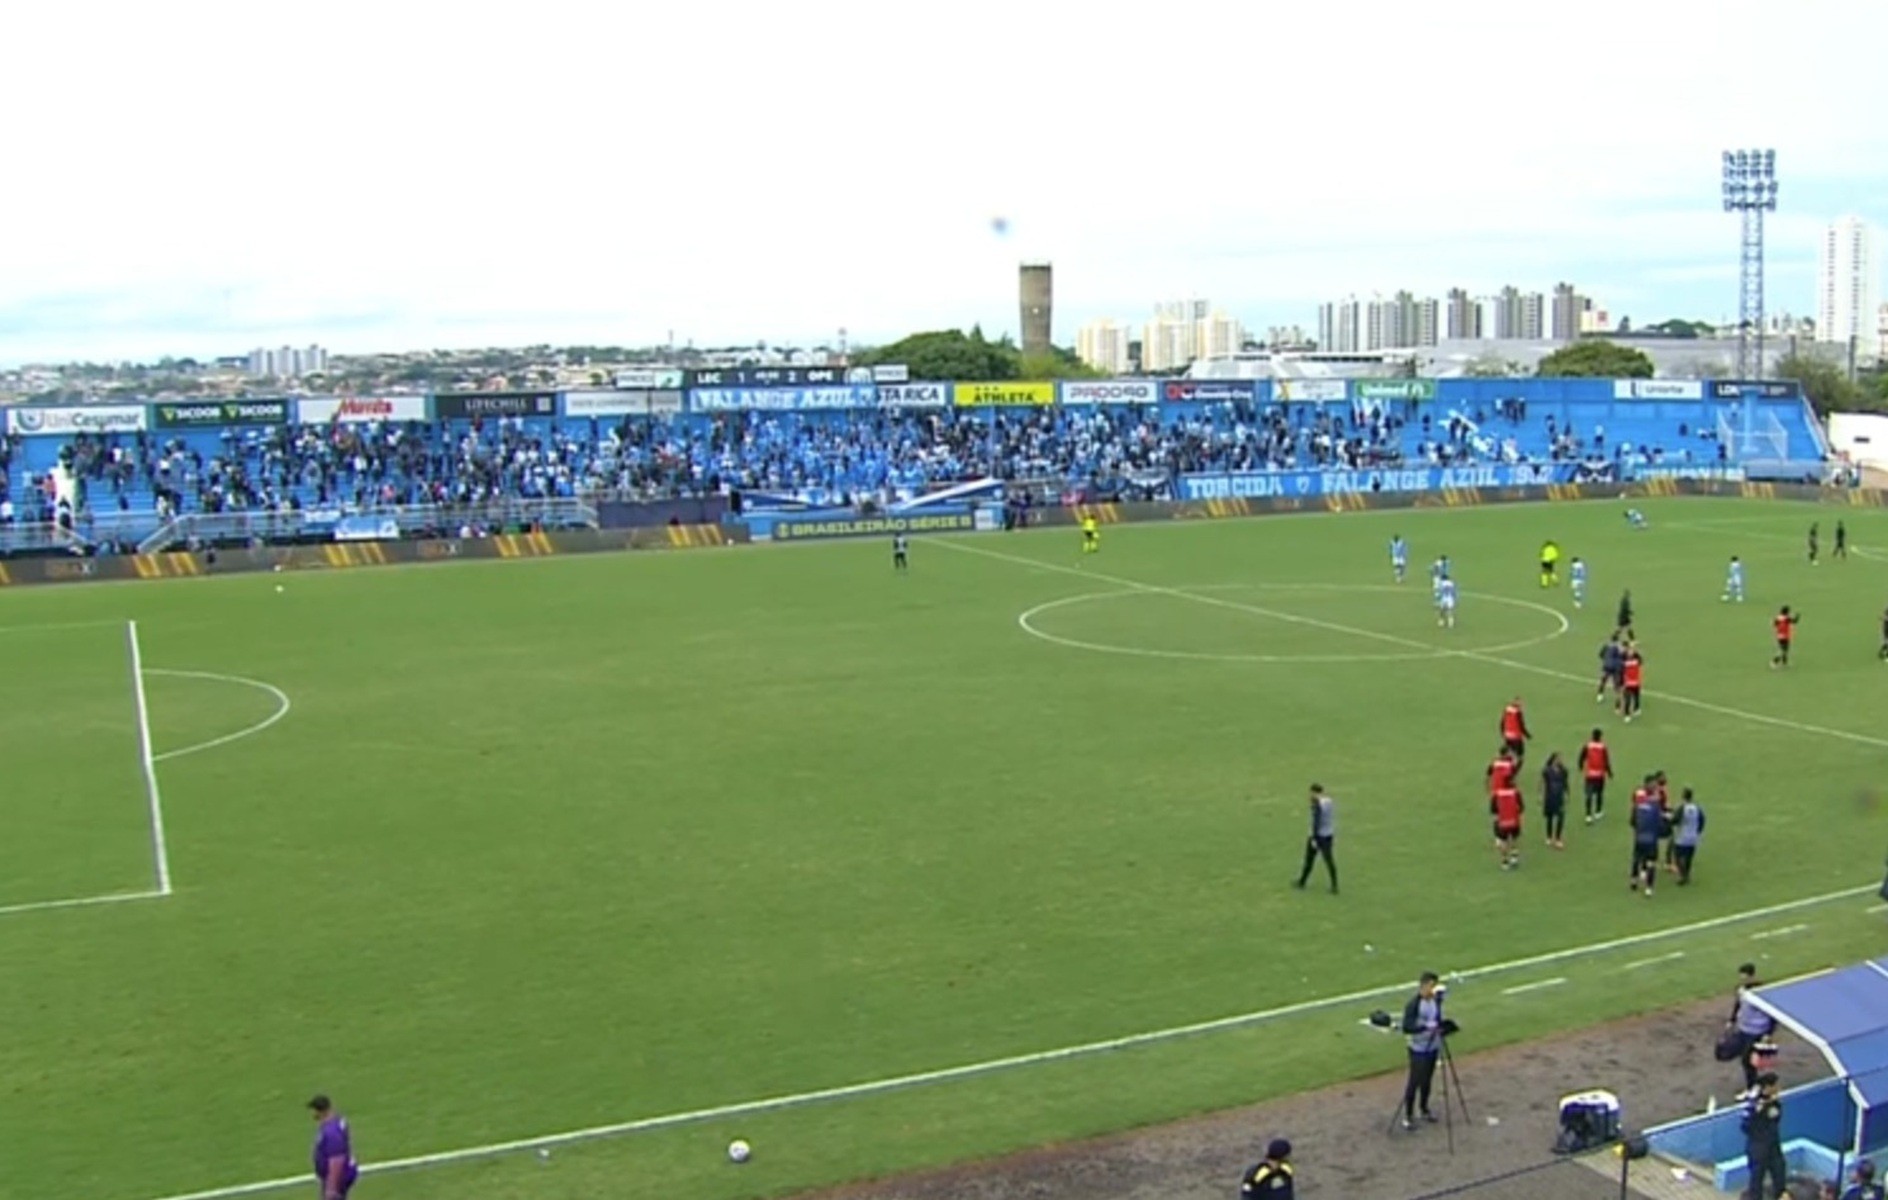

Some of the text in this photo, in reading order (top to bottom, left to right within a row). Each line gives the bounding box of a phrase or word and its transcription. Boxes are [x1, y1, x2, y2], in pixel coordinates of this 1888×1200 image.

[1187, 476, 1284, 499] TORCIDA
[1440, 466, 1500, 488] AZUL
[792, 517, 908, 536] BRASILEIRÃO
[909, 515, 959, 531] SÉRIE
